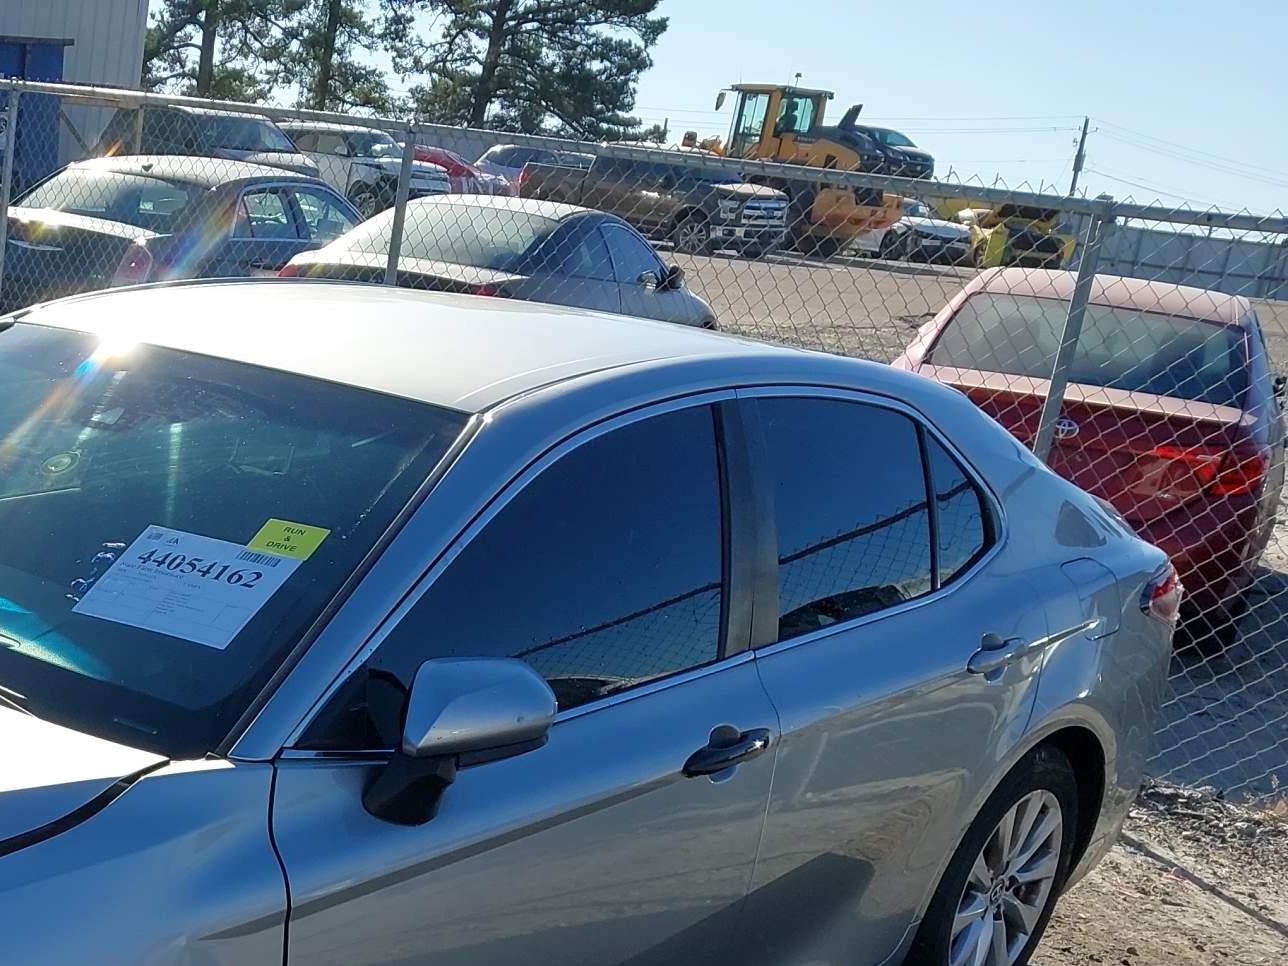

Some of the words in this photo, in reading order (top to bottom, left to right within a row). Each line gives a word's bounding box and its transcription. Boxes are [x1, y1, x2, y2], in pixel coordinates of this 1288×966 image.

[283, 526, 306, 536] RUN
[265, 540, 297, 552] DRIVE
[137, 548, 263, 589] 44054162
